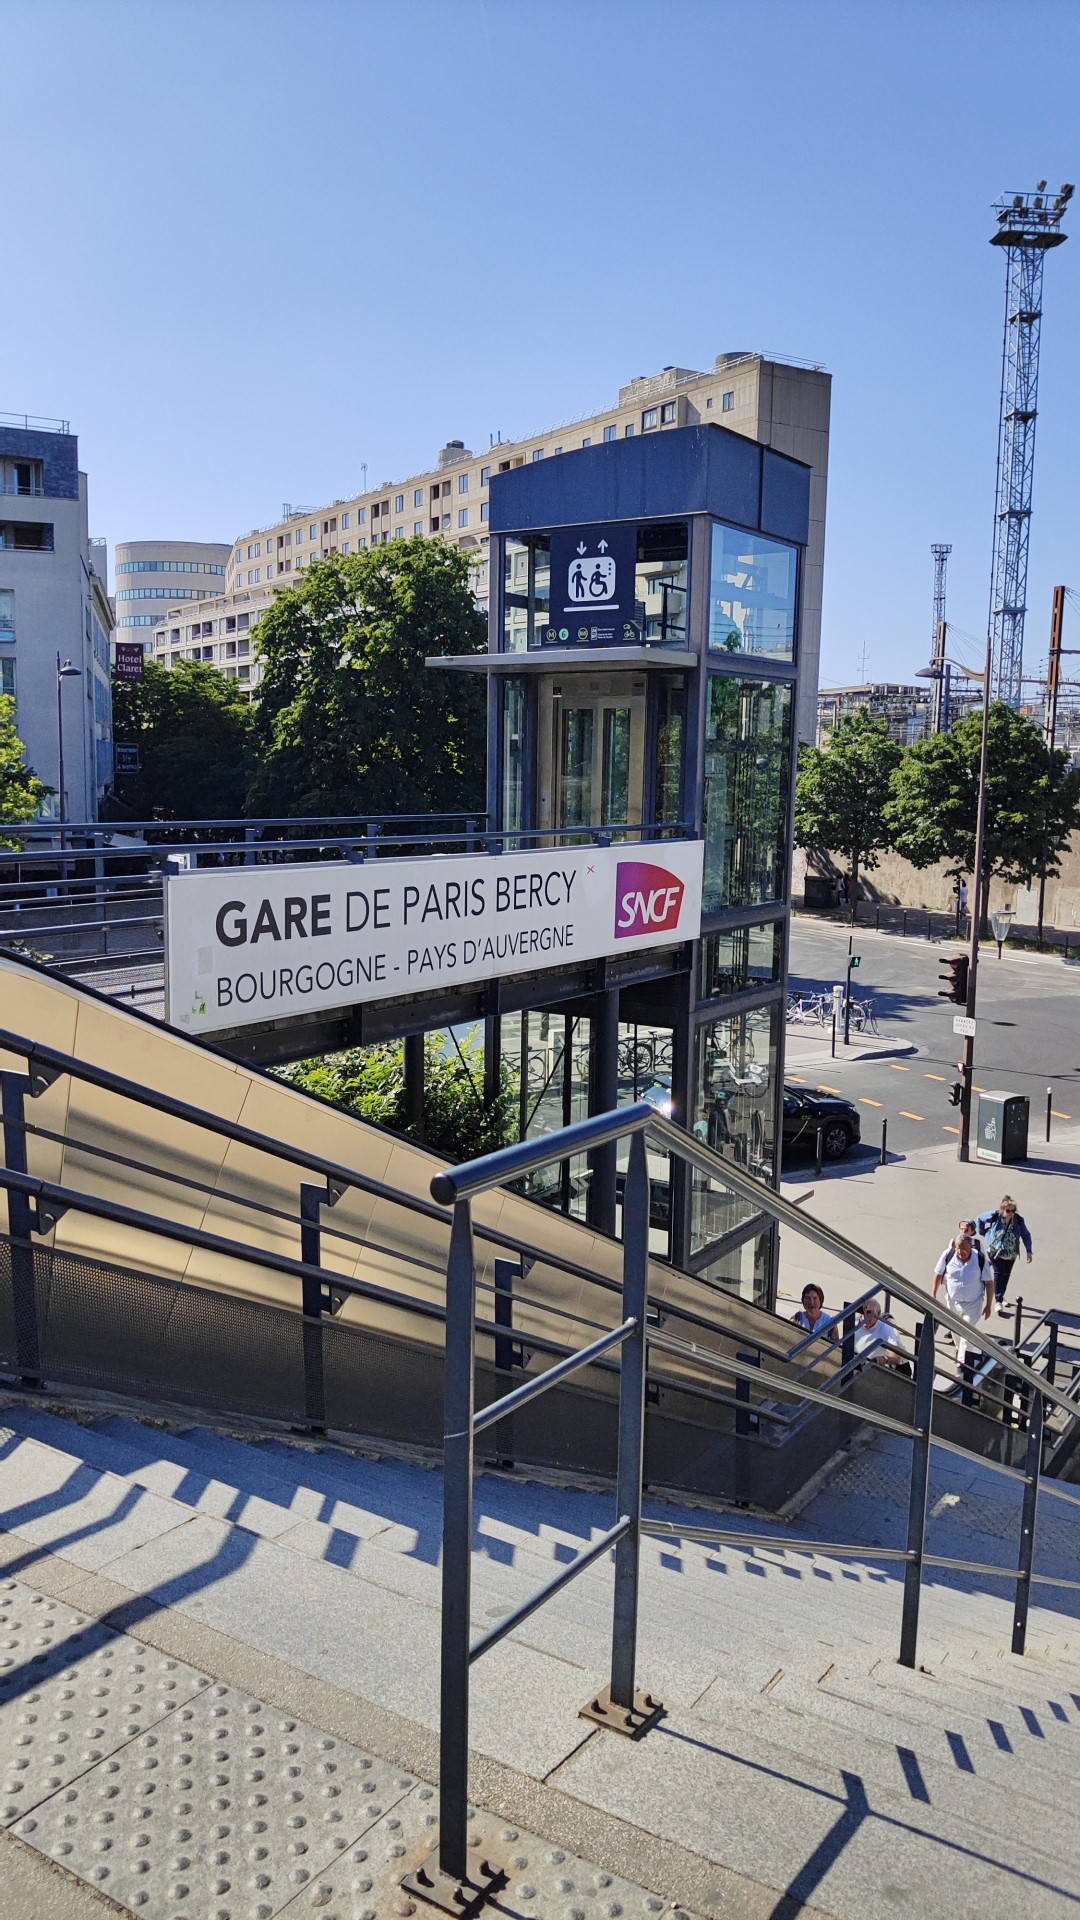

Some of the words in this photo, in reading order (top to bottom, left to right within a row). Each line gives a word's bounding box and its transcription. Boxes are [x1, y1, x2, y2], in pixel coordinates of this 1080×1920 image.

[117, 663, 143, 673] Claret
[118, 655, 142, 664] Hotel
[215, 893, 332, 948] GARE
[346, 888, 391, 933] DE
[403, 878, 486, 926] PARIS
[496, 869, 577, 913] BERCY
[617, 886, 680, 928] SNCF
[217, 953, 387, 1007] BOURGOGNE
[407, 942, 457, 975] PAYS
[463, 924, 574, 965] D'AUVERGNE
